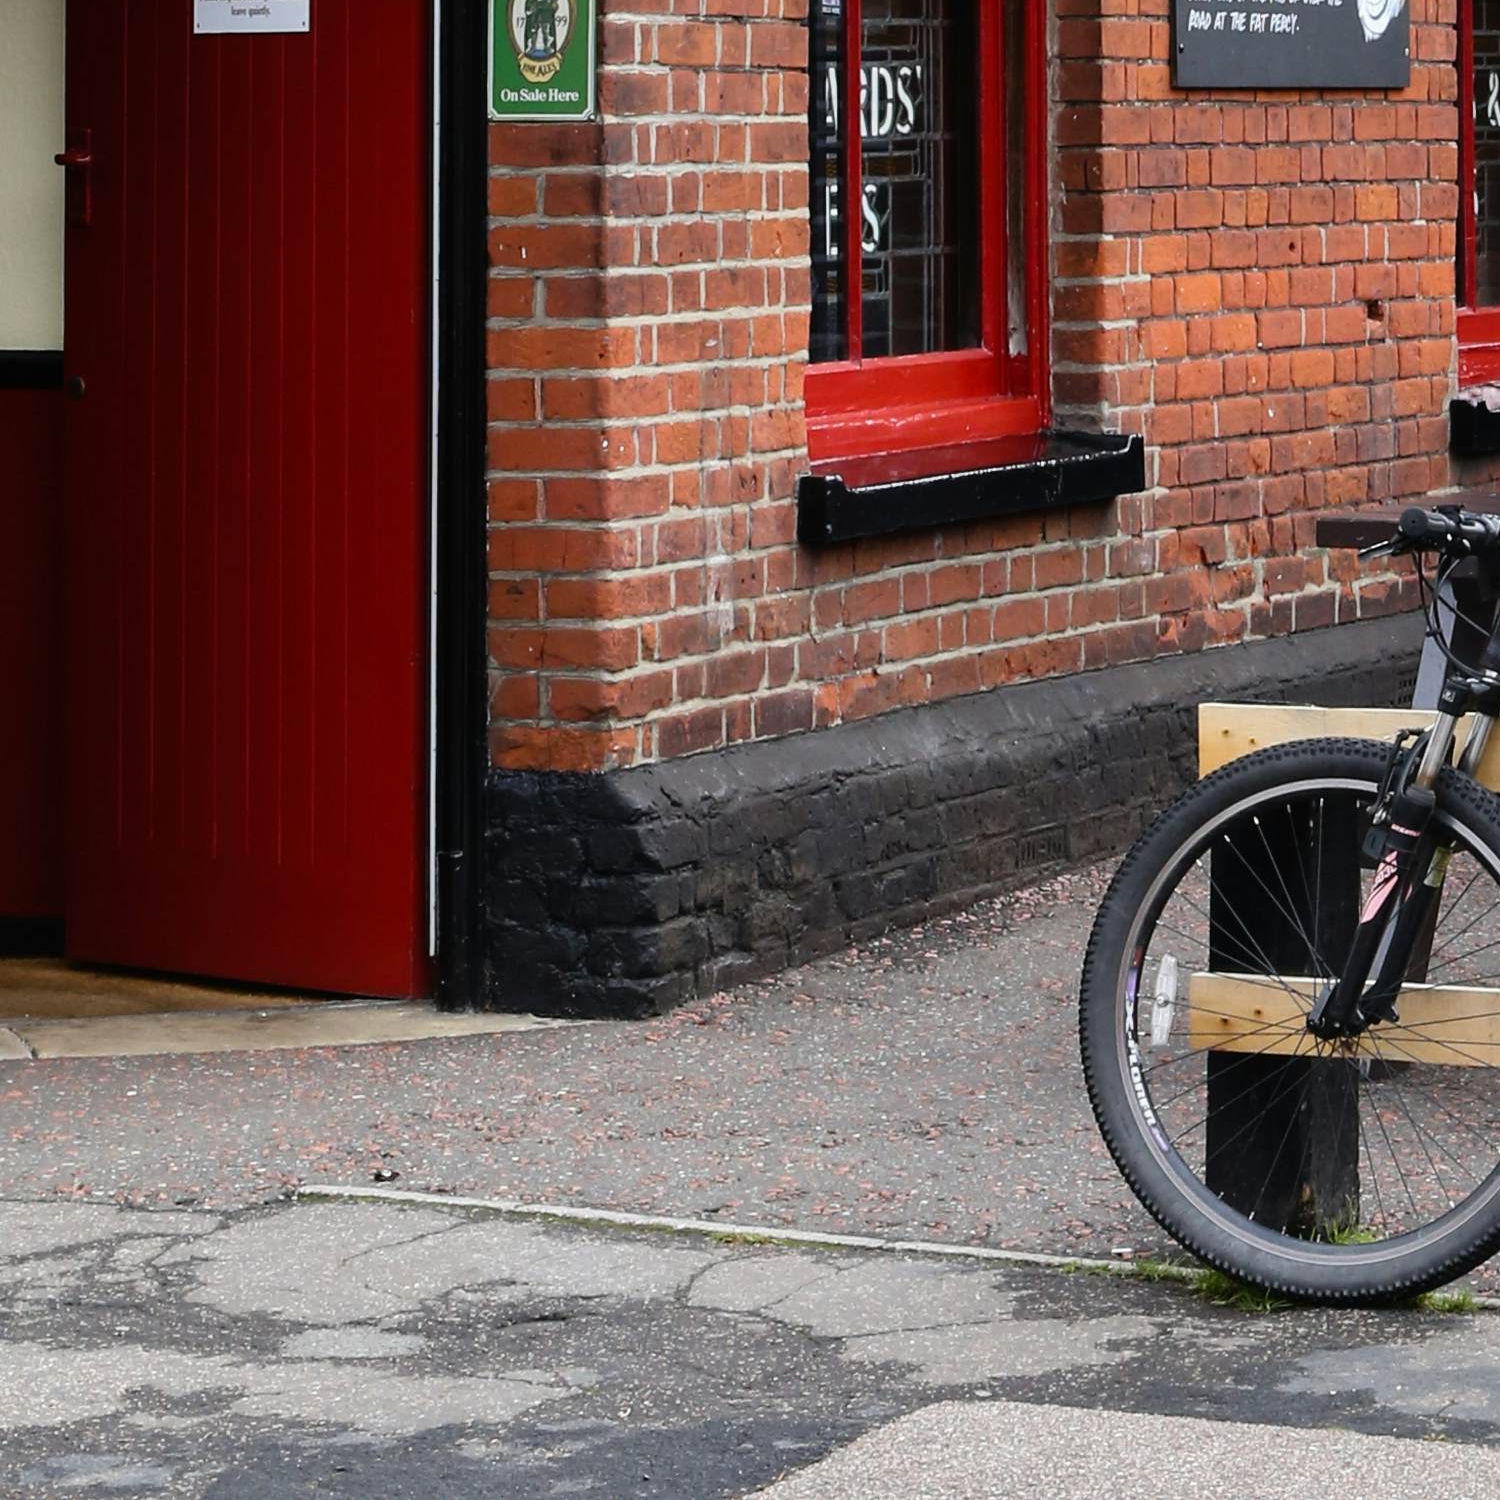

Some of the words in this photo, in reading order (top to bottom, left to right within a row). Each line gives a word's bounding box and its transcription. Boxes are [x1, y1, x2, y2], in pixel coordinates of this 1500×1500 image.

[555, 15, 567, 28] 99
[1188, 9, 1211, 31] ROAD
[1214, 12, 1227, 31] AT
[1230, 12, 1247, 31] THE
[1249, 13, 1269, 33] FAT
[500, 88, 518, 102] On
[520, 88, 547, 102] Sale
[548, 88, 579, 102] Here
